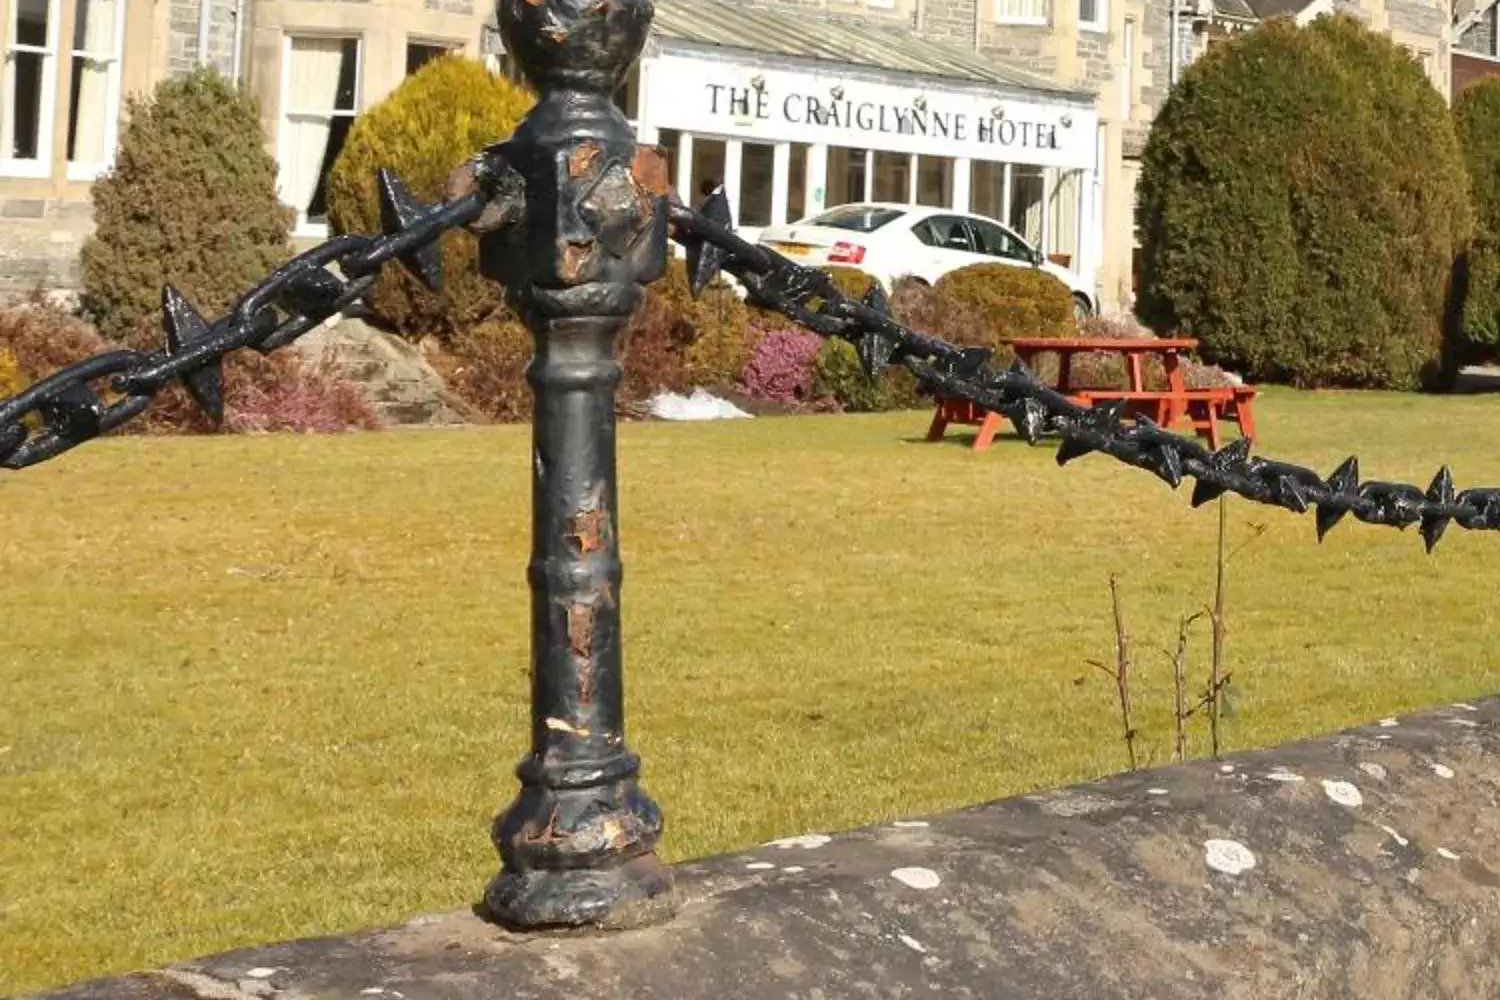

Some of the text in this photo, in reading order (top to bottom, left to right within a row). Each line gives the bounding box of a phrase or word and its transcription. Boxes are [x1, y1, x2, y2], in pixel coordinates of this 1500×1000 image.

[707, 84, 1063, 150] THE CRAIGLYNNE HOTEL
